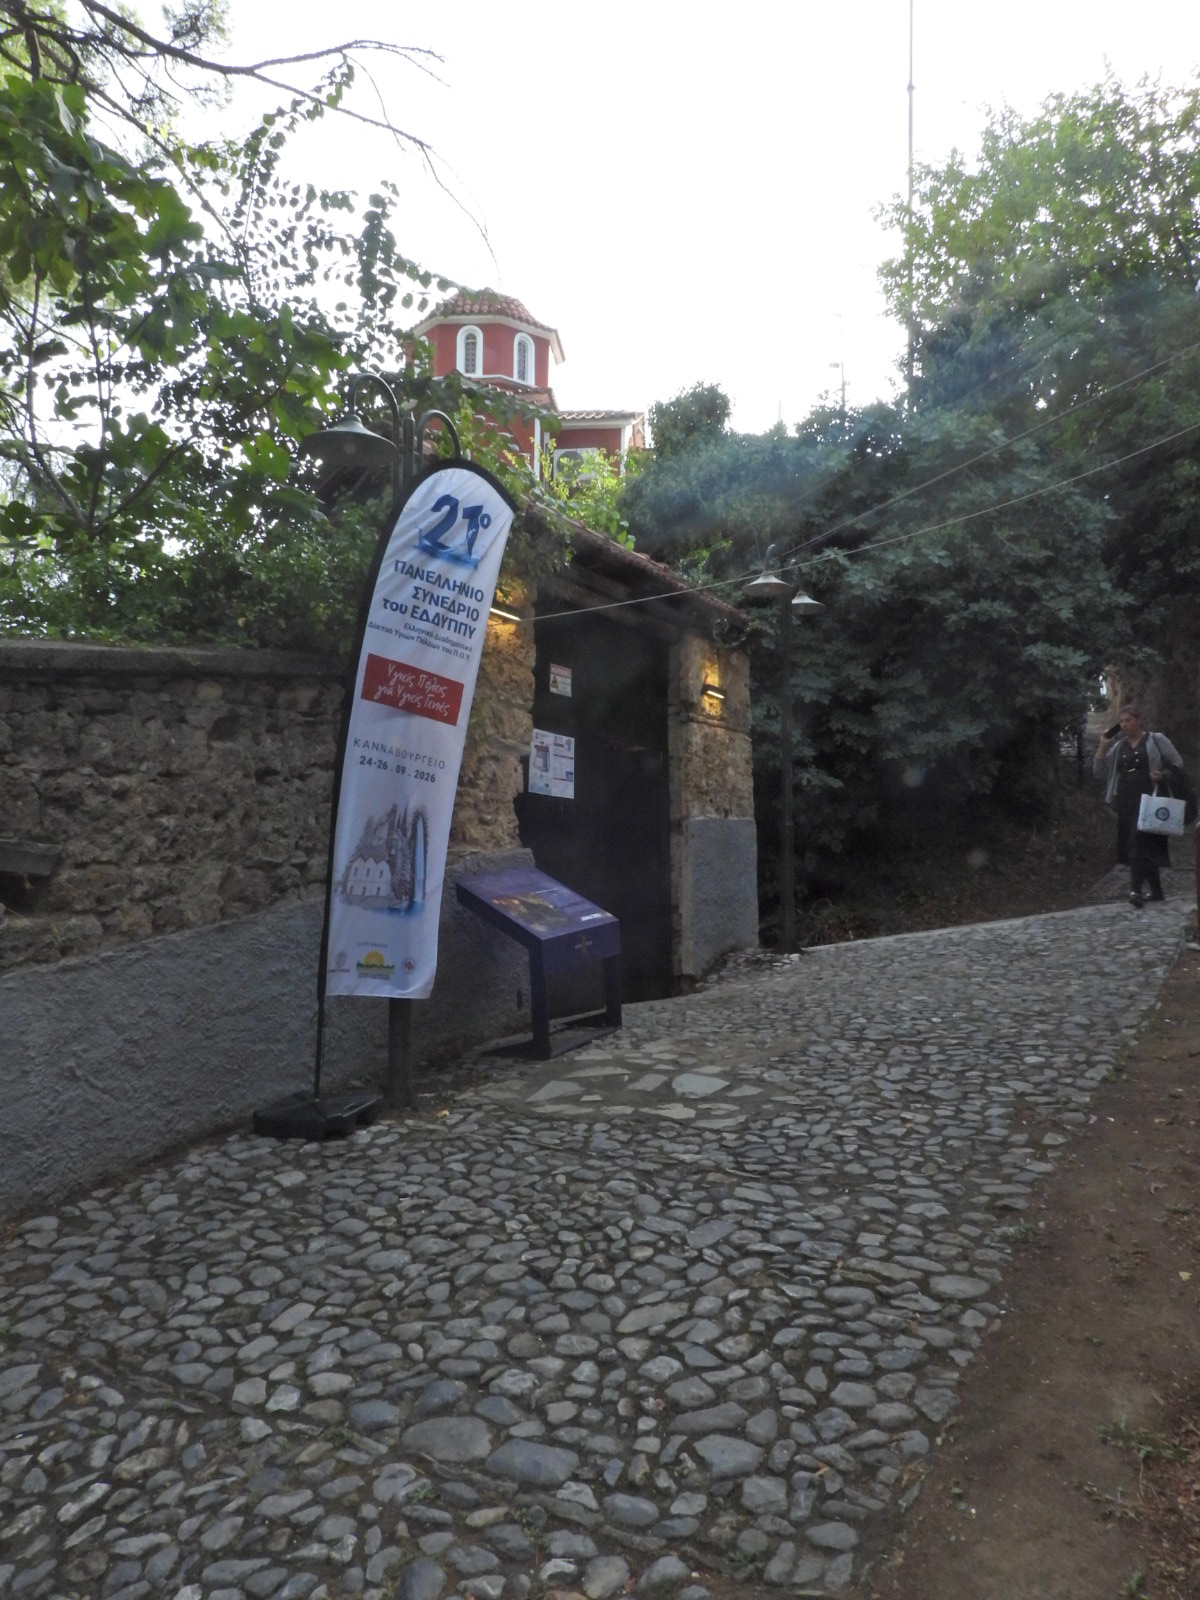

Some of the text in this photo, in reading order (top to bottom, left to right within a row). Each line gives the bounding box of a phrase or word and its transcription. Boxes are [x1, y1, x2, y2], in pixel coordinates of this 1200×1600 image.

[394, 559, 485, 602] ΠΑΝΕΛΛΗΝΙΟ
[382, 598, 477, 639] του ΕΔΔΥΠΠΥ
[411, 585, 480, 622] ΣΥΝΕΔΡΙΟ
